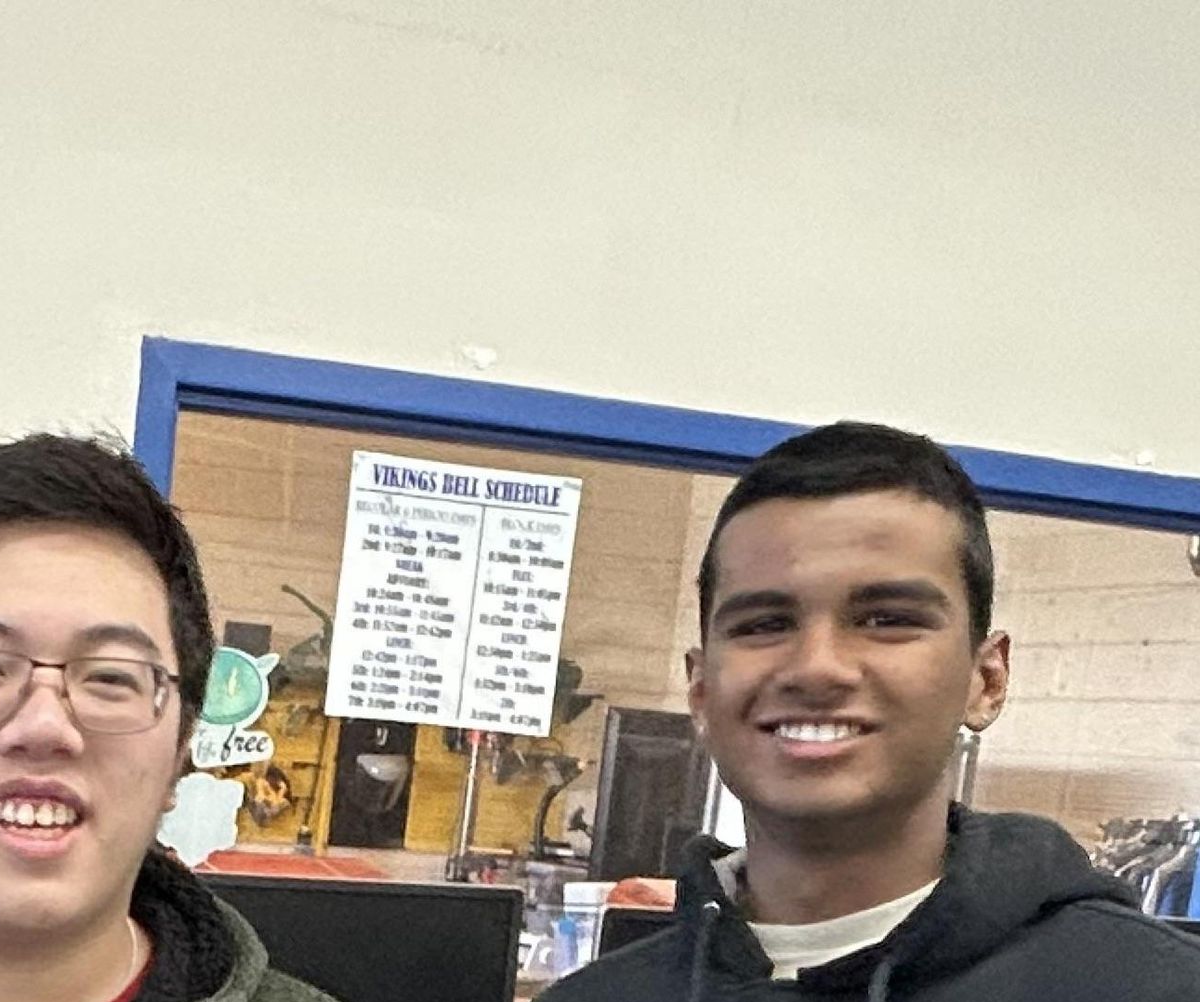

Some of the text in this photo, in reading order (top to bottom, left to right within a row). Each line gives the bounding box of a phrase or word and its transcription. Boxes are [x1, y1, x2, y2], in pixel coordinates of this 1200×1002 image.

[373, 463, 561, 507] VIKINGS BELL SCHEDULE
[220, 725, 269, 762] free
